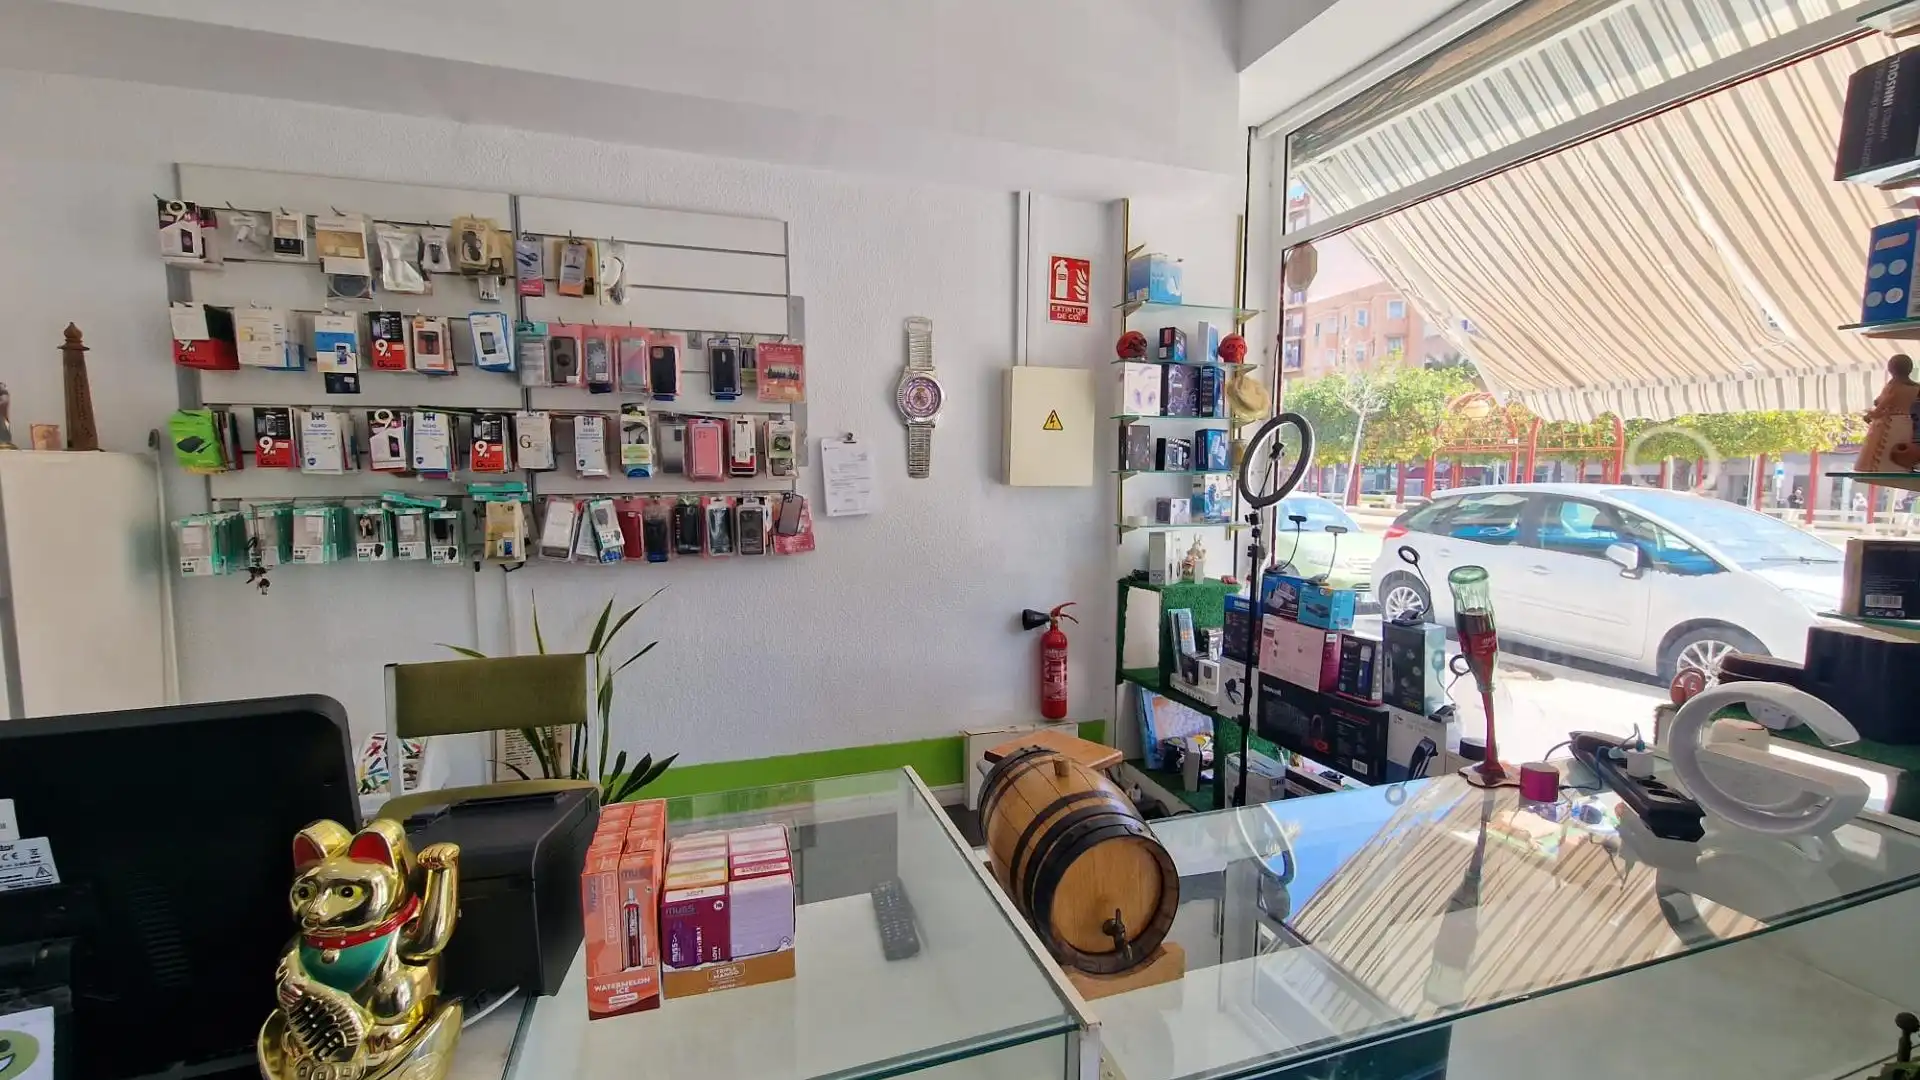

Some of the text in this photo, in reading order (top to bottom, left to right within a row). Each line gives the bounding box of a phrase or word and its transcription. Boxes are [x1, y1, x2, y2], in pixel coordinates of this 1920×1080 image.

[1882, 57, 1900, 107] INNSOUL
[1051, 305, 1087, 315] EXTINTOR
[1056, 312, 1067, 320] DE
[666, 904, 697, 916] muss
[593, 975, 651, 993] WATERMELON
[616, 986, 630, 995] ICE
